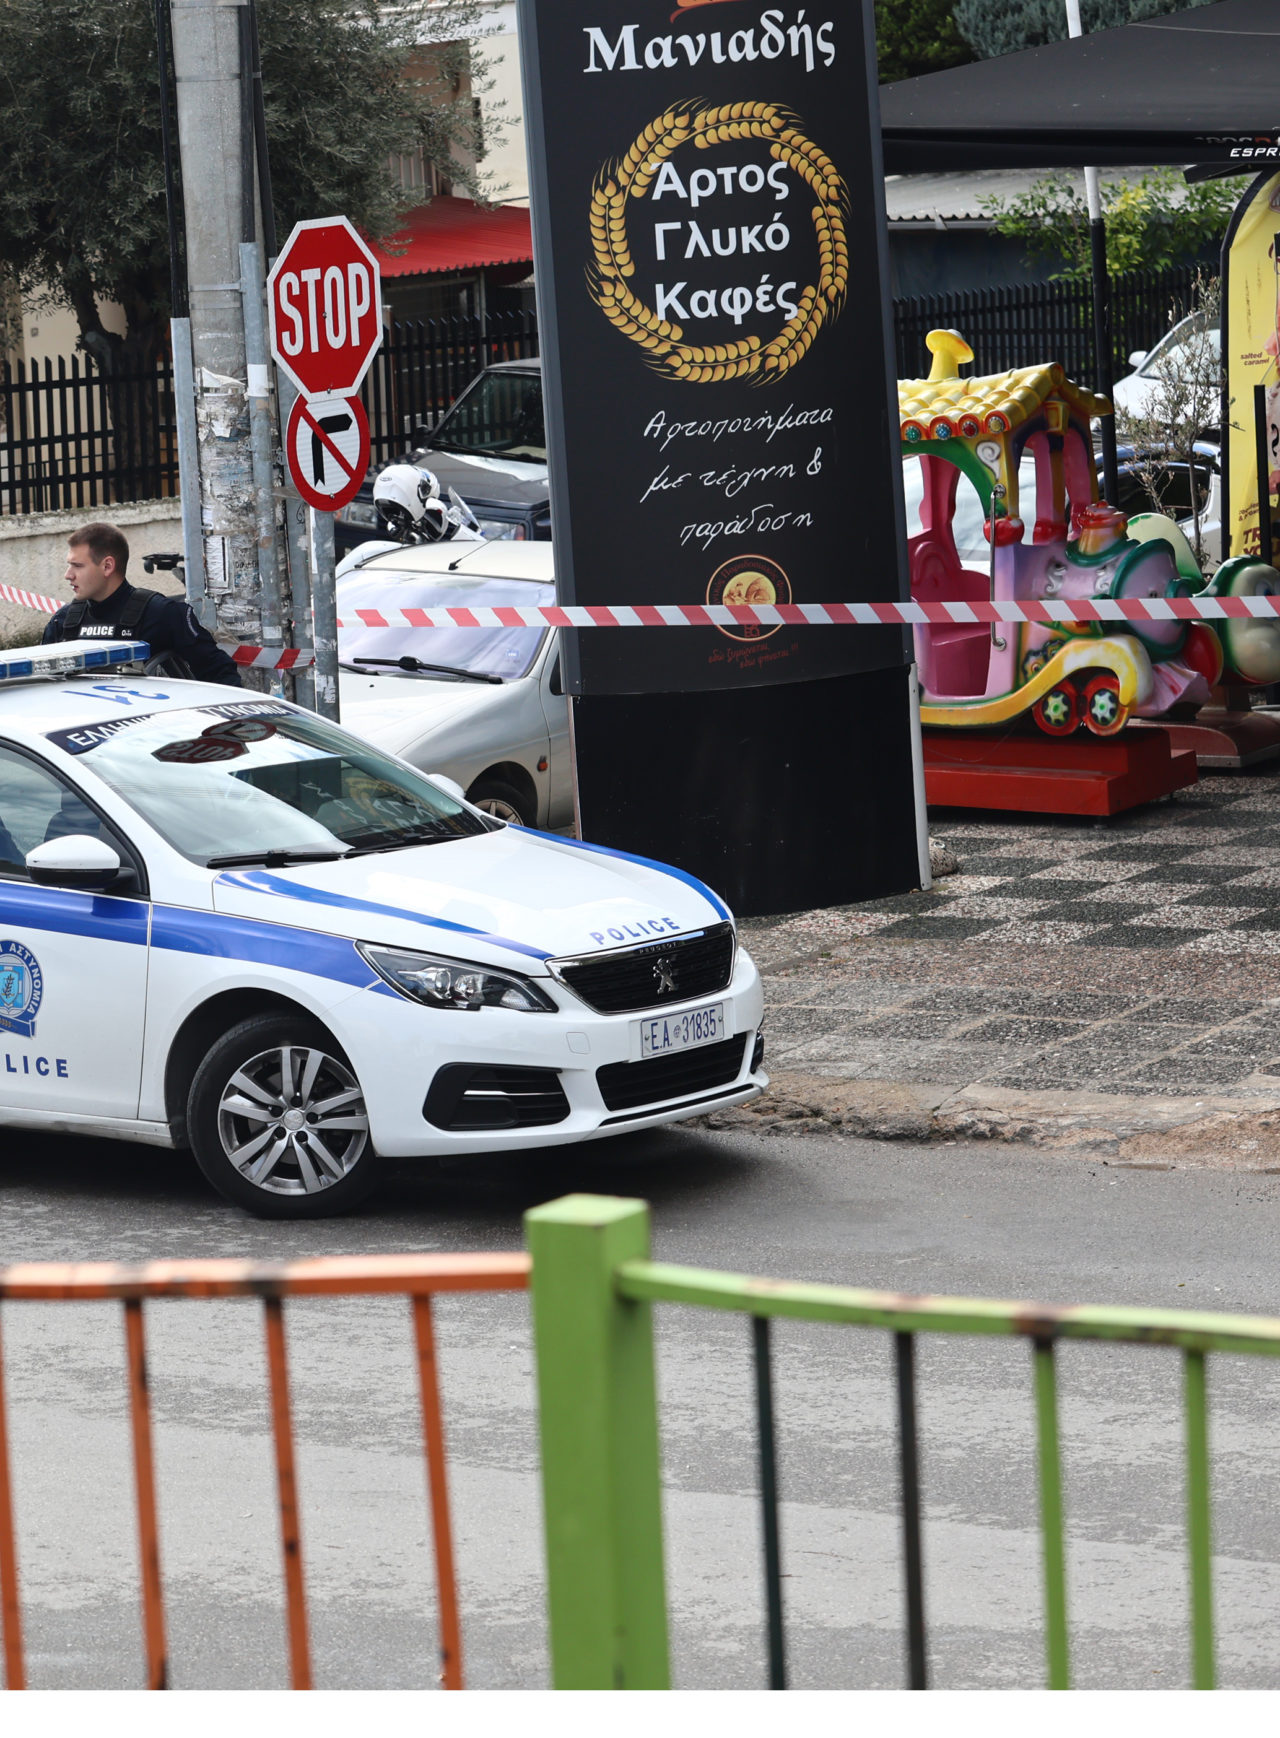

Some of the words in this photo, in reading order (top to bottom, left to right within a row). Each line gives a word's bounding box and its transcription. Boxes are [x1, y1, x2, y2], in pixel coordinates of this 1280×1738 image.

[583, 9, 836, 73] Μανιαδής
[1230, 147, 1280, 157] ESPR
[650, 160, 789, 208] Άρτος
[654, 212, 790, 261] Γλυκό
[279, 262, 371, 356] STOP
[654, 274, 799, 325] Καφές
[639, 465, 692, 503] με
[699, 463, 796, 498] τέχνη
[806, 446, 823, 476] &
[680, 503, 814, 551] παράδοση
[80, 625, 114, 636] POLICE
[589, 917, 681, 945] POLICE
[9, 942, 43, 1015] ΑΣΤΥΝΟΜΙΑ
[682, 1008, 717, 1043] 31835
